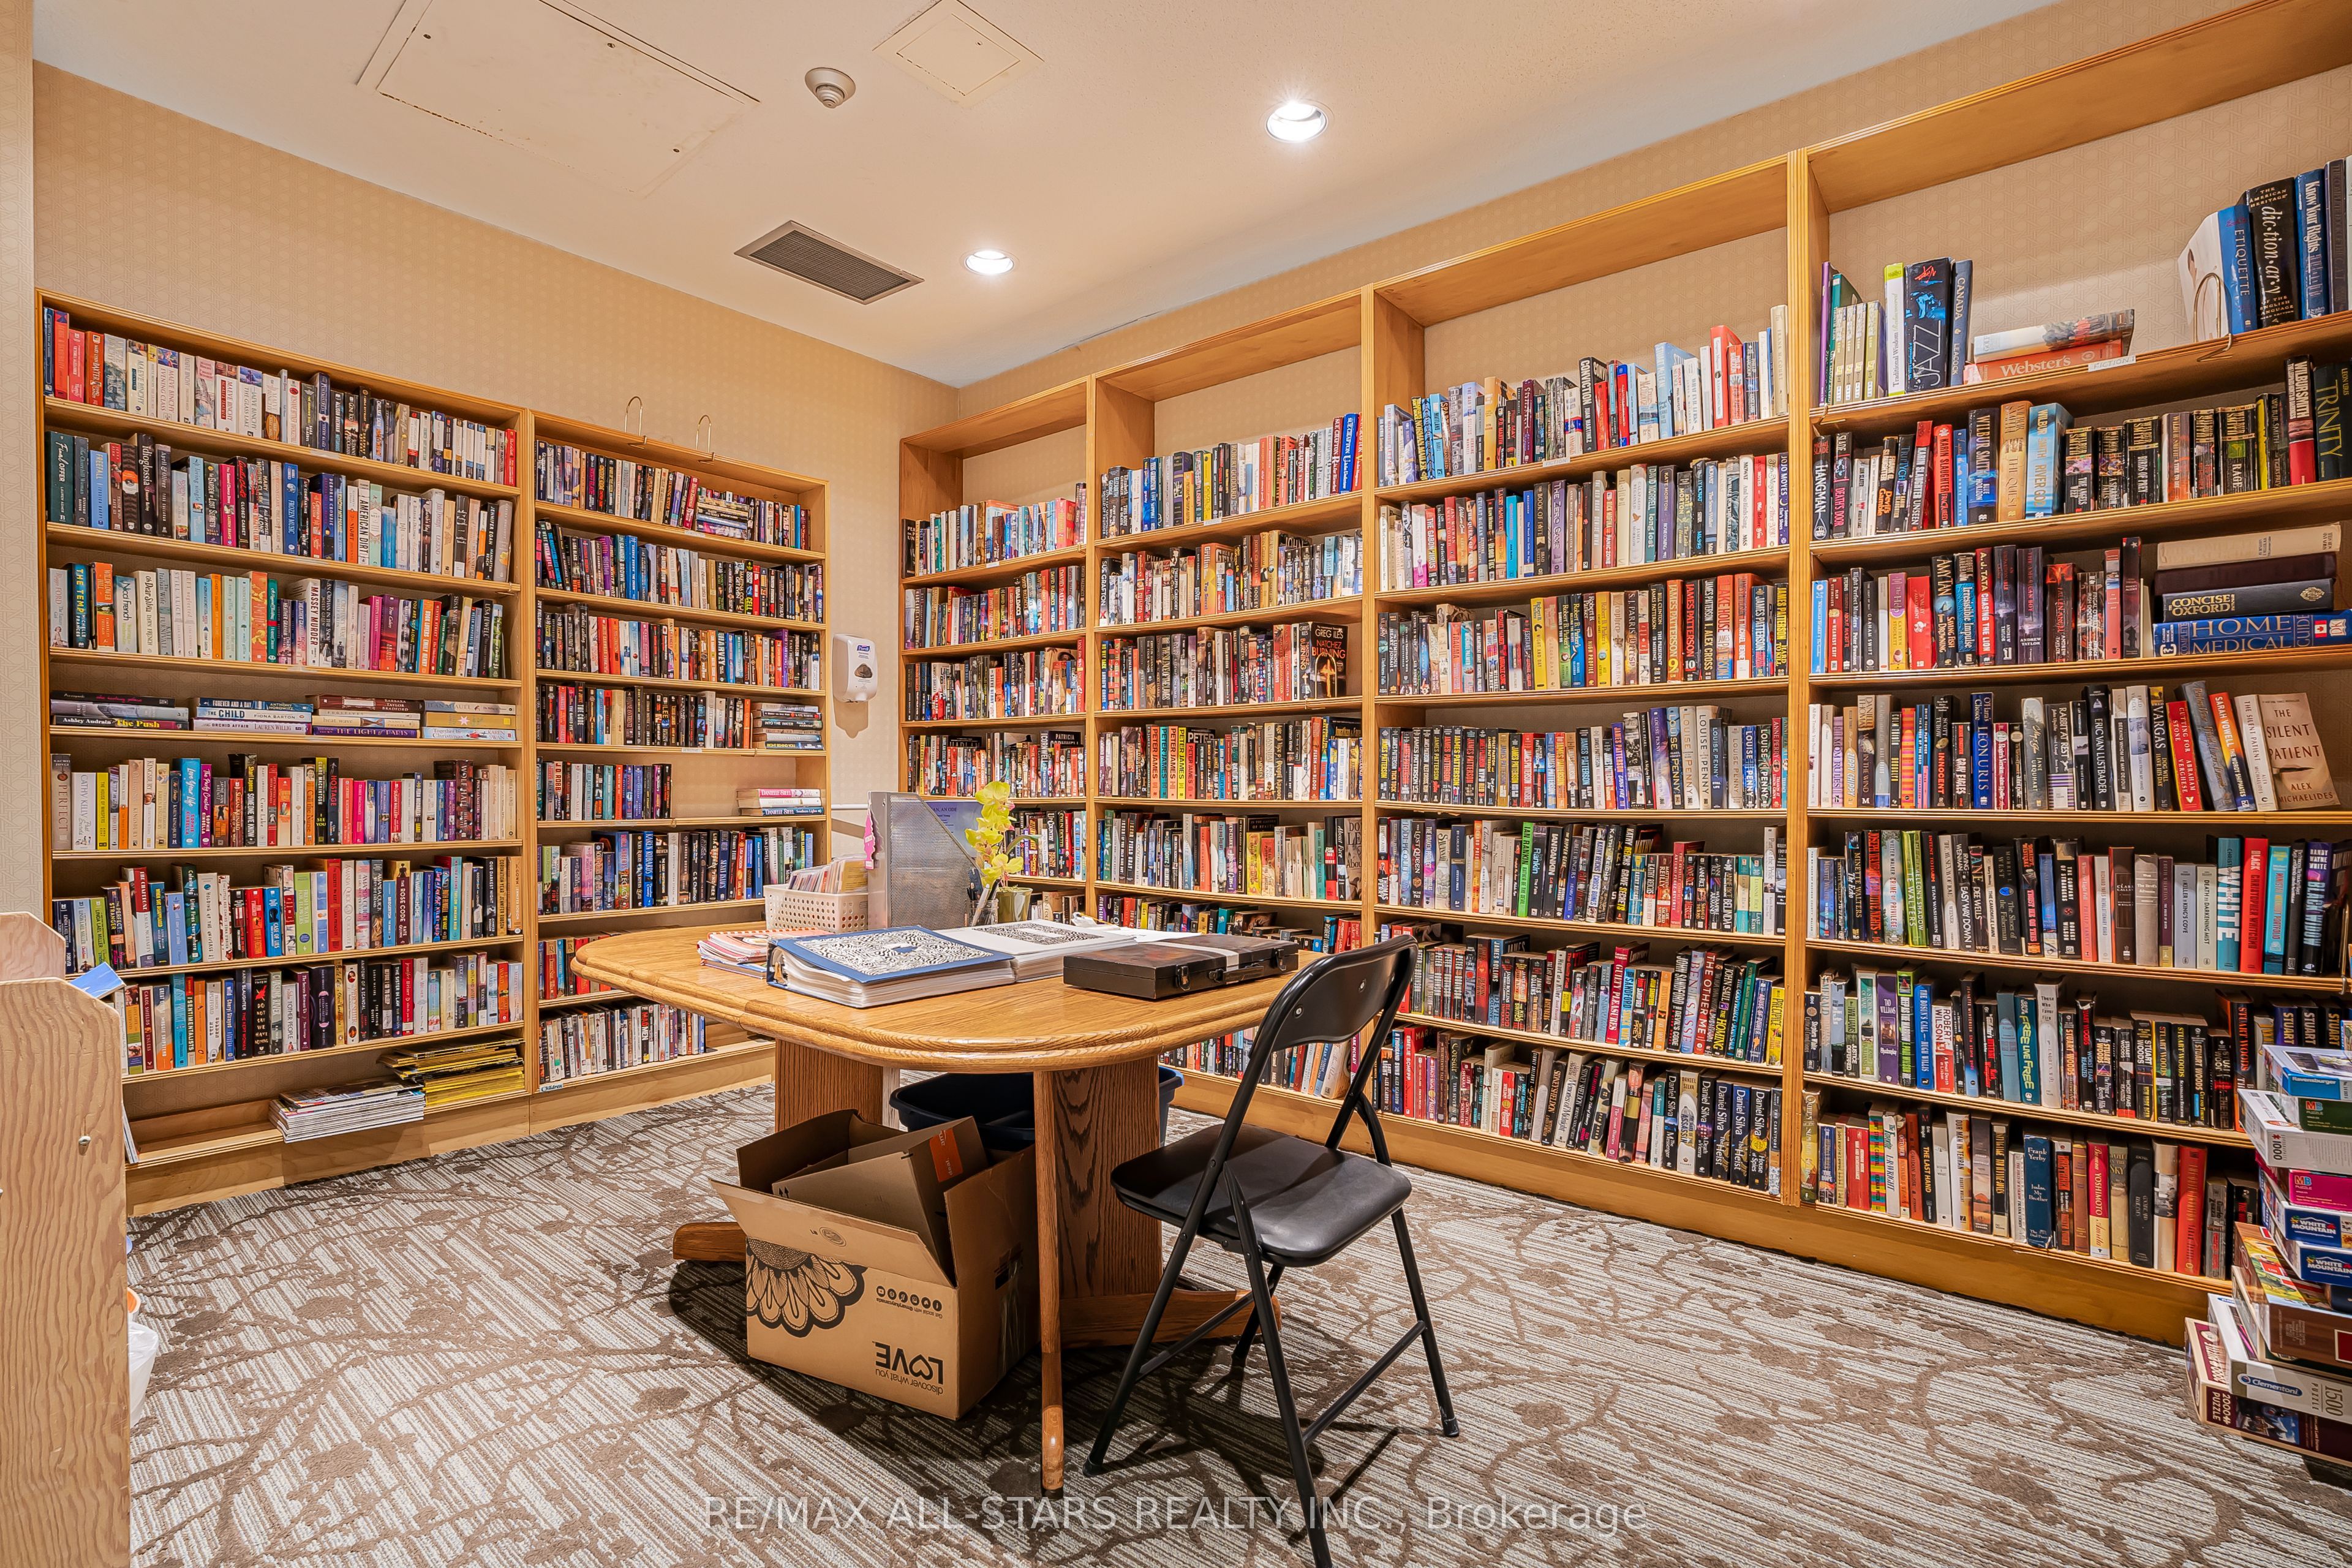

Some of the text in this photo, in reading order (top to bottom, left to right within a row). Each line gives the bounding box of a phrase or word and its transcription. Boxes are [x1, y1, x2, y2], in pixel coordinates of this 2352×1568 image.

[2250, 189, 2287, 203] AMERICAN
[2303, 181, 2322, 252] Know Your Rights
[2234, 229, 2250, 296] ETIQUETTE
[1954, 277, 1966, 321] CANADA
[1913, 320, 1941, 387] JAZZ
[2000, 356, 2071, 377] Webster's
[1581, 360, 1592, 405] CONVICTION
[1891, 356, 1899, 387] Traditional
[2295, 361, 2310, 418] WILBUR SMITH
[2315, 380, 2343, 456] TRINITY
[1940, 439, 1949, 457] KARIN
[95, 454, 104, 479] FREEFALL
[139, 445, 153, 485] idioglossia
[1940, 459, 1950, 492] SLAUGHTER
[2138, 456, 2148, 472] BIRDS
[2232, 464, 2242, 488] RAGE
[1815, 465, 1828, 513] HANGMAN
[2007, 457, 2019, 508] THE QUEST
[2034, 465, 2047, 507] RIVER GOD
[2138, 480, 2148, 493] PREY
[1647, 513, 1656, 530] long
[1834, 487, 1845, 526] DEATH'S DOOR
[121, 582, 131, 621] Nicci French
[309, 586, 319, 644] MASSEY MURDER
[1893, 595, 1902, 612] Help
[2171, 594, 2231, 608] CONCISE
[2171, 603, 2231, 616] OXFORD
[1686, 584, 1695, 657] JAMES PATTERSON
[1962, 587, 1974, 649] Irresistible Impulse
[1980, 593, 1991, 651] CHASING THE LION
[2192, 614, 2292, 637] HOME
[2297, 614, 2310, 647] GUIDE
[2331, 620, 2343, 635] DK
[1311, 647, 1346, 658] BURNING
[1317, 639, 1342, 648] NATCHEZ
[2179, 622, 2188, 655] COMPLETE
[2192, 635, 2291, 655] MEDICAL
[62, 717, 85, 725] Ashley
[218, 709, 245, 718] CHILD
[2154, 706, 2166, 748] VARGAS
[2179, 707, 2188, 737] CUTTING
[2215, 696, 2234, 747] SARAH VOWELL
[2095, 737, 2104, 750] VAN
[2265, 724, 2310, 737] SILENT
[1669, 714, 1679, 791] LOUISE PENNY
[2269, 745, 2321, 760] PATIENT
[2097, 752, 2106, 793] LUSTBADER
[2178, 759, 2187, 793] VERGHESE
[2186, 760, 2196, 791] ABRAHAM
[2231, 756, 2239, 773] WORDY
[2235, 773, 2246, 797] SHIPMATES
[58, 784, 69, 832] PERFECT
[2279, 791, 2334, 802] MICHAELIDES
[1617, 828, 1634, 910] KATHY REICHS GRAVE SECRETS
[1970, 852, 1983, 883] JANE
[1961, 886, 1972, 942] EASY WAY DOWN
[2217, 865, 2240, 942] WHITE
[2304, 881, 2325, 946] BLACK WIDOW
[1672, 956, 1688, 1004] JOHN SANDFORD
[1697, 955, 1716, 1033] THE OTHER ME
[1682, 962, 1700, 1042] BEN SASSE
[2019, 1016, 2030, 1044] FREE
[2328, 1013, 2339, 1046] STUART
[2022, 1060, 2034, 1089] FREE
[2291, 1076, 2336, 1085] Ravensburger
[1754, 1091, 1765, 1136] Daniel Silva
[2305, 1101, 2323, 1111] MB
[2272, 1140, 2282, 1161] 1000
[2291, 1223, 2337, 1235] MOUNTAIN
[2299, 1219, 2326, 1229] WHITE
[2307, 1262, 2352, 1273] MOUNTAIN
[2315, 1257, 2337, 1266] WHITE
[875, 1368, 943, 1395] discover what you
[2252, 1378, 2299, 1395] Clementoni
[2212, 1392, 2220, 1420] PUZZLE
[2222, 1394, 2231, 1415] 2000
[2325, 1385, 2343, 1417] 1500
